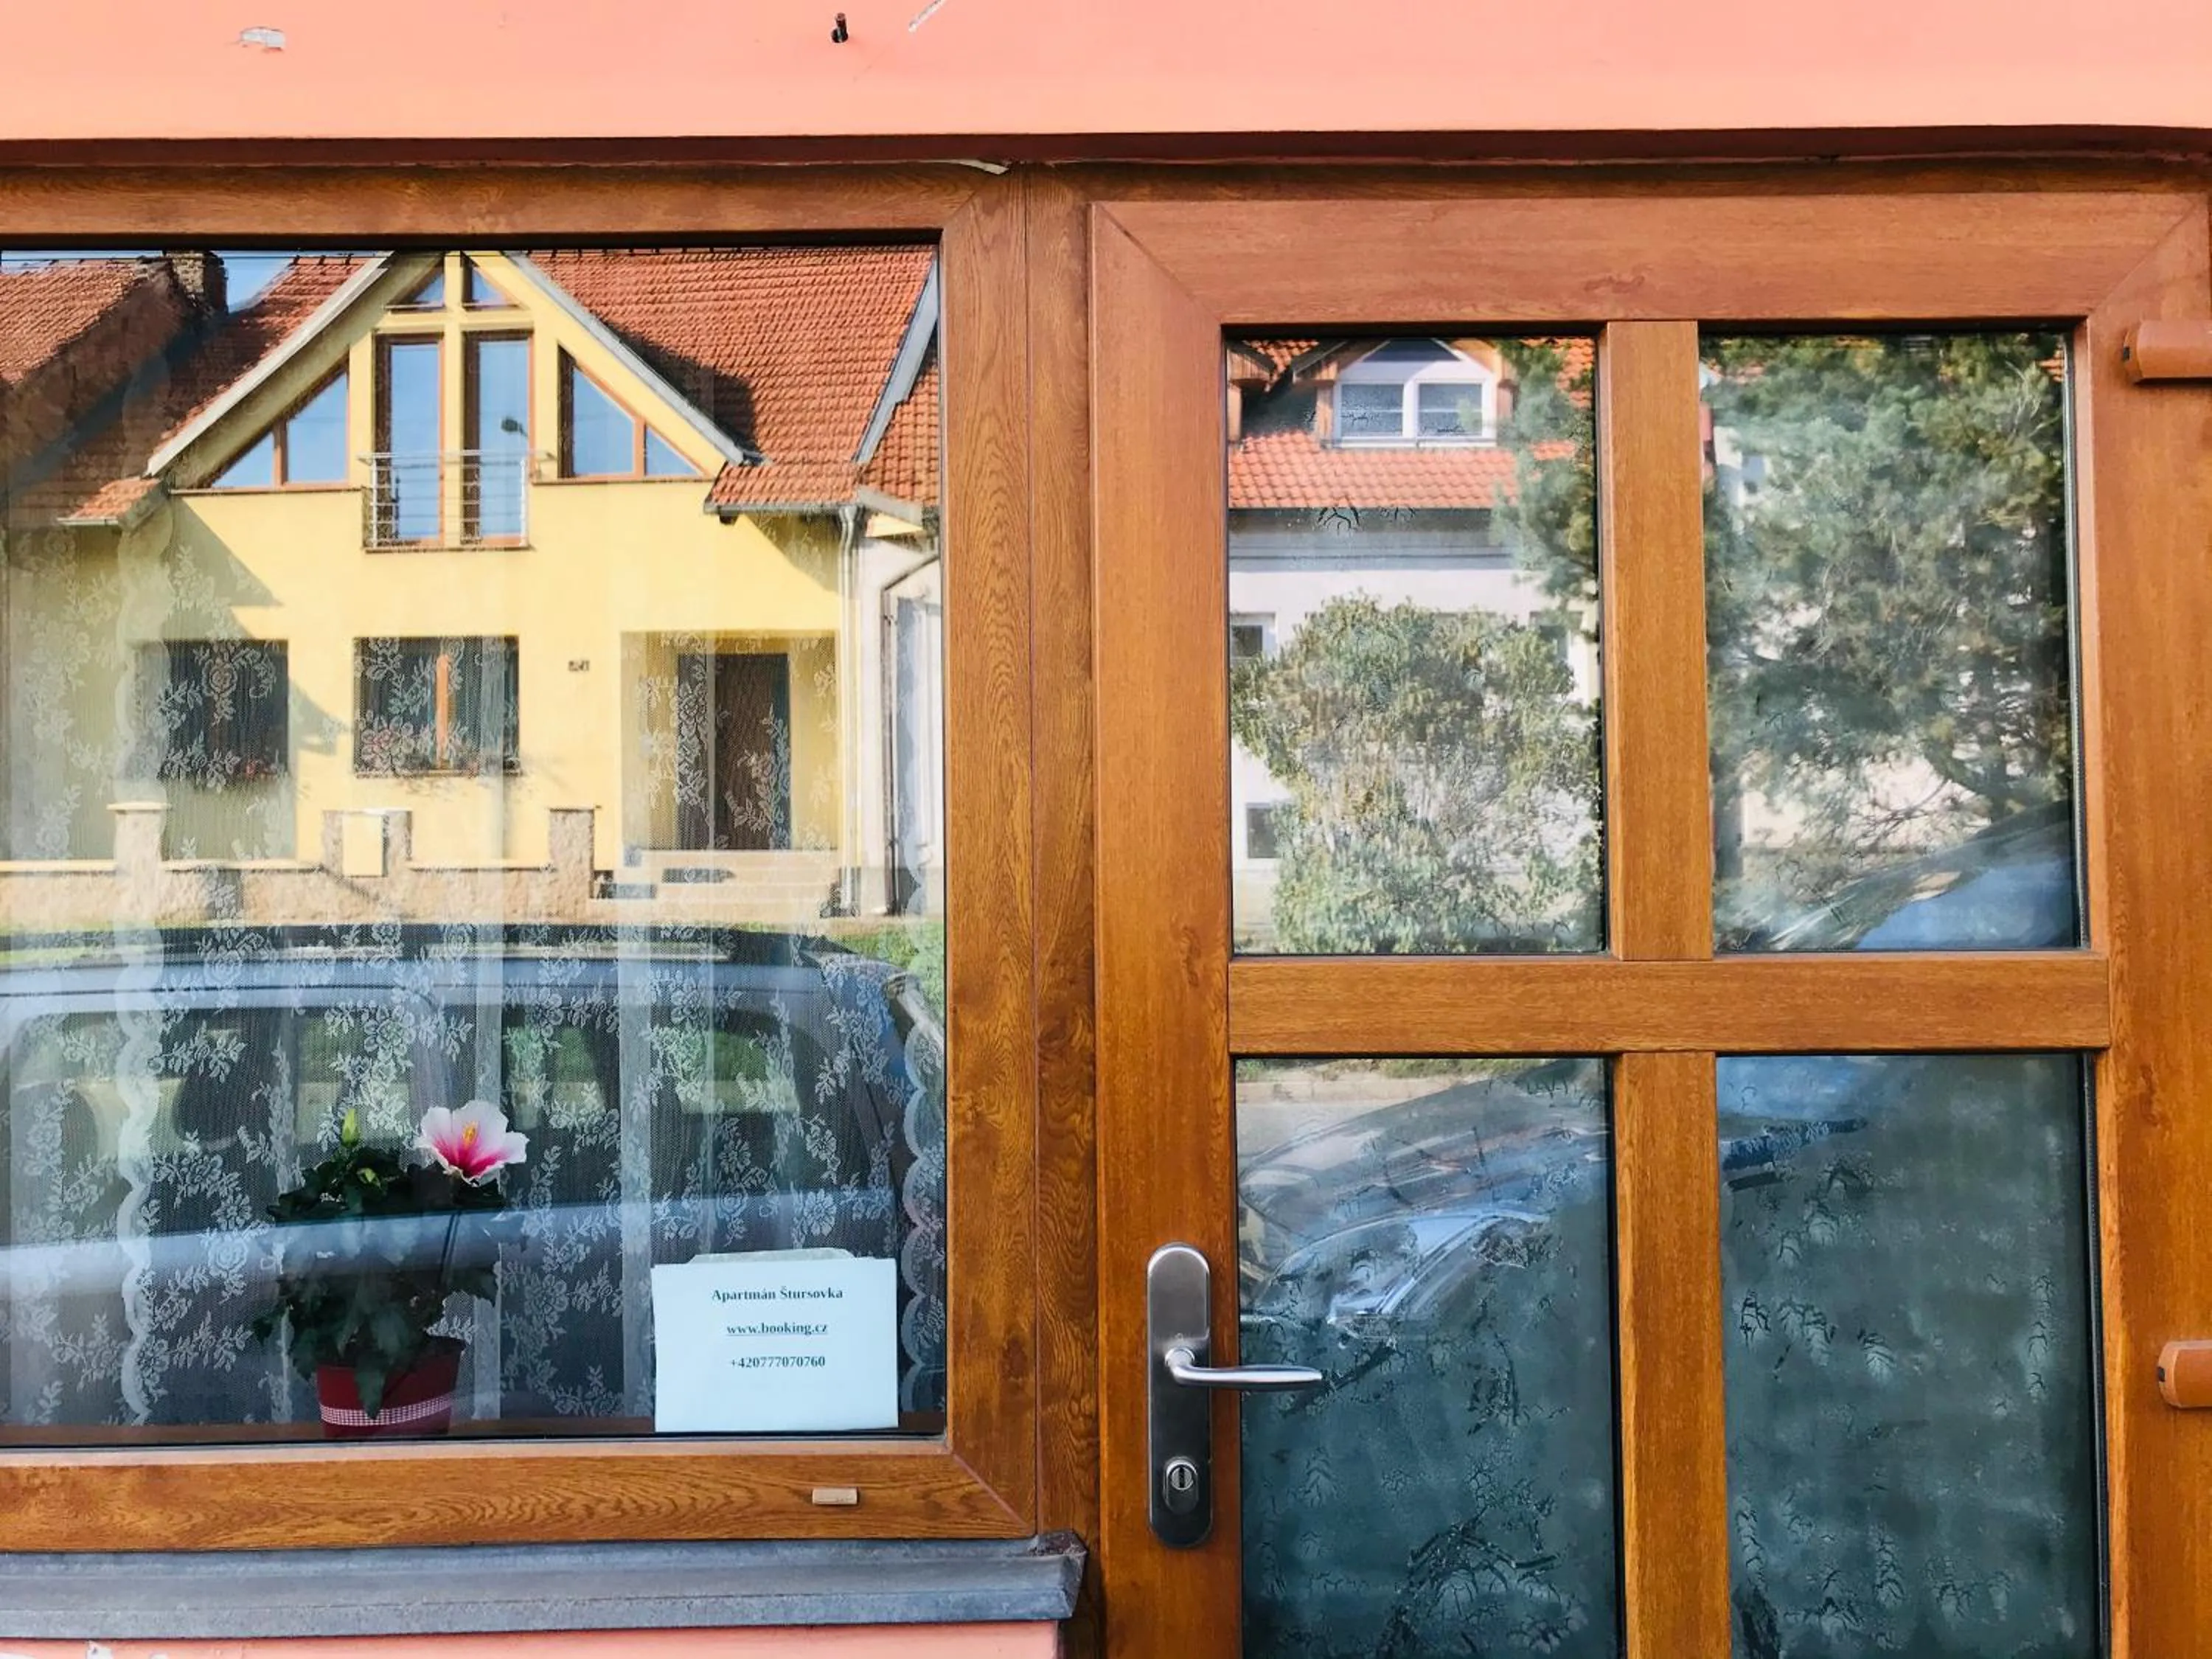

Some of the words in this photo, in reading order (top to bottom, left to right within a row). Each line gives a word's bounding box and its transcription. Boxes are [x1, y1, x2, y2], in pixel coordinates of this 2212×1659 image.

[712, 1287, 776, 1302] Apartmán
[779, 1285, 843, 1299] Štursovka
[726, 1322, 827, 1335] www.booking.cz
[730, 1356, 826, 1368] +420777070760
